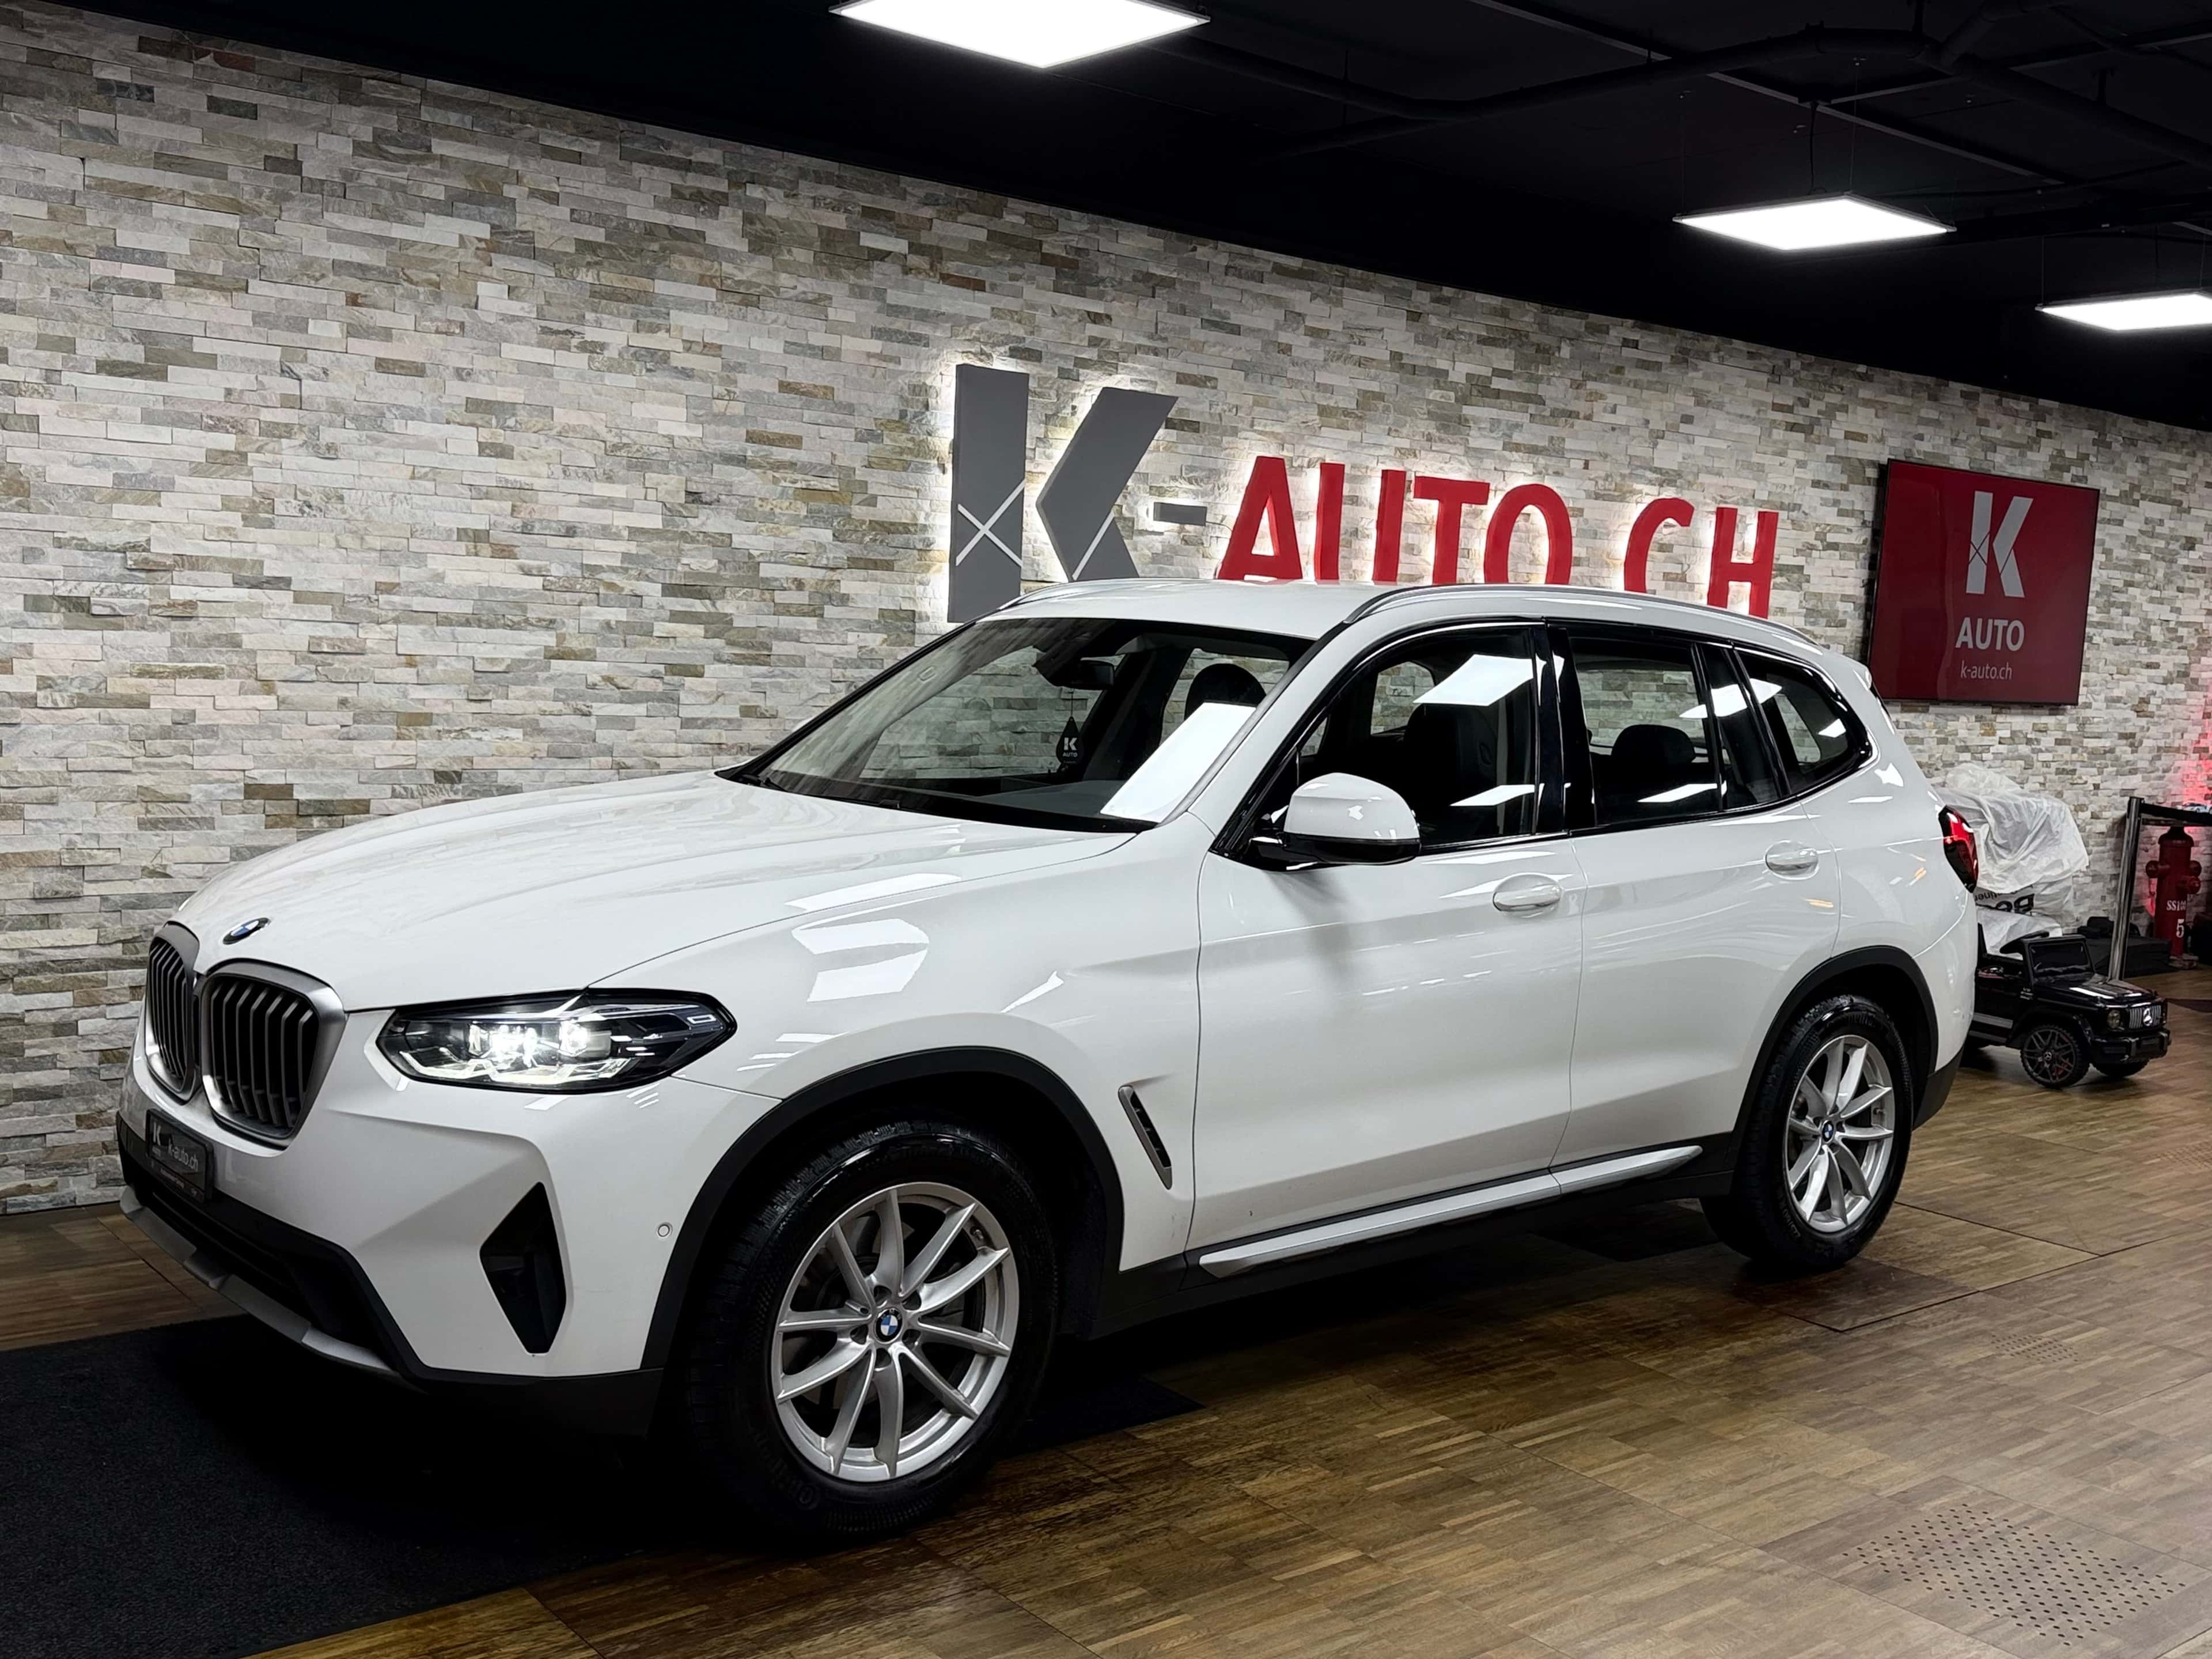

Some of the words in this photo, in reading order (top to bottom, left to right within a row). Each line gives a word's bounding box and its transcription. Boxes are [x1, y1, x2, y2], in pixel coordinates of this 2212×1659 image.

[1966, 491, 2033, 598] K
[1955, 617, 2025, 652] AUTO
[1960, 660, 2012, 680] k-auto.ch
[1064, 737, 1077, 751] K
[2176, 918, 2185, 938] 5
[153, 1122, 162, 1146] K
